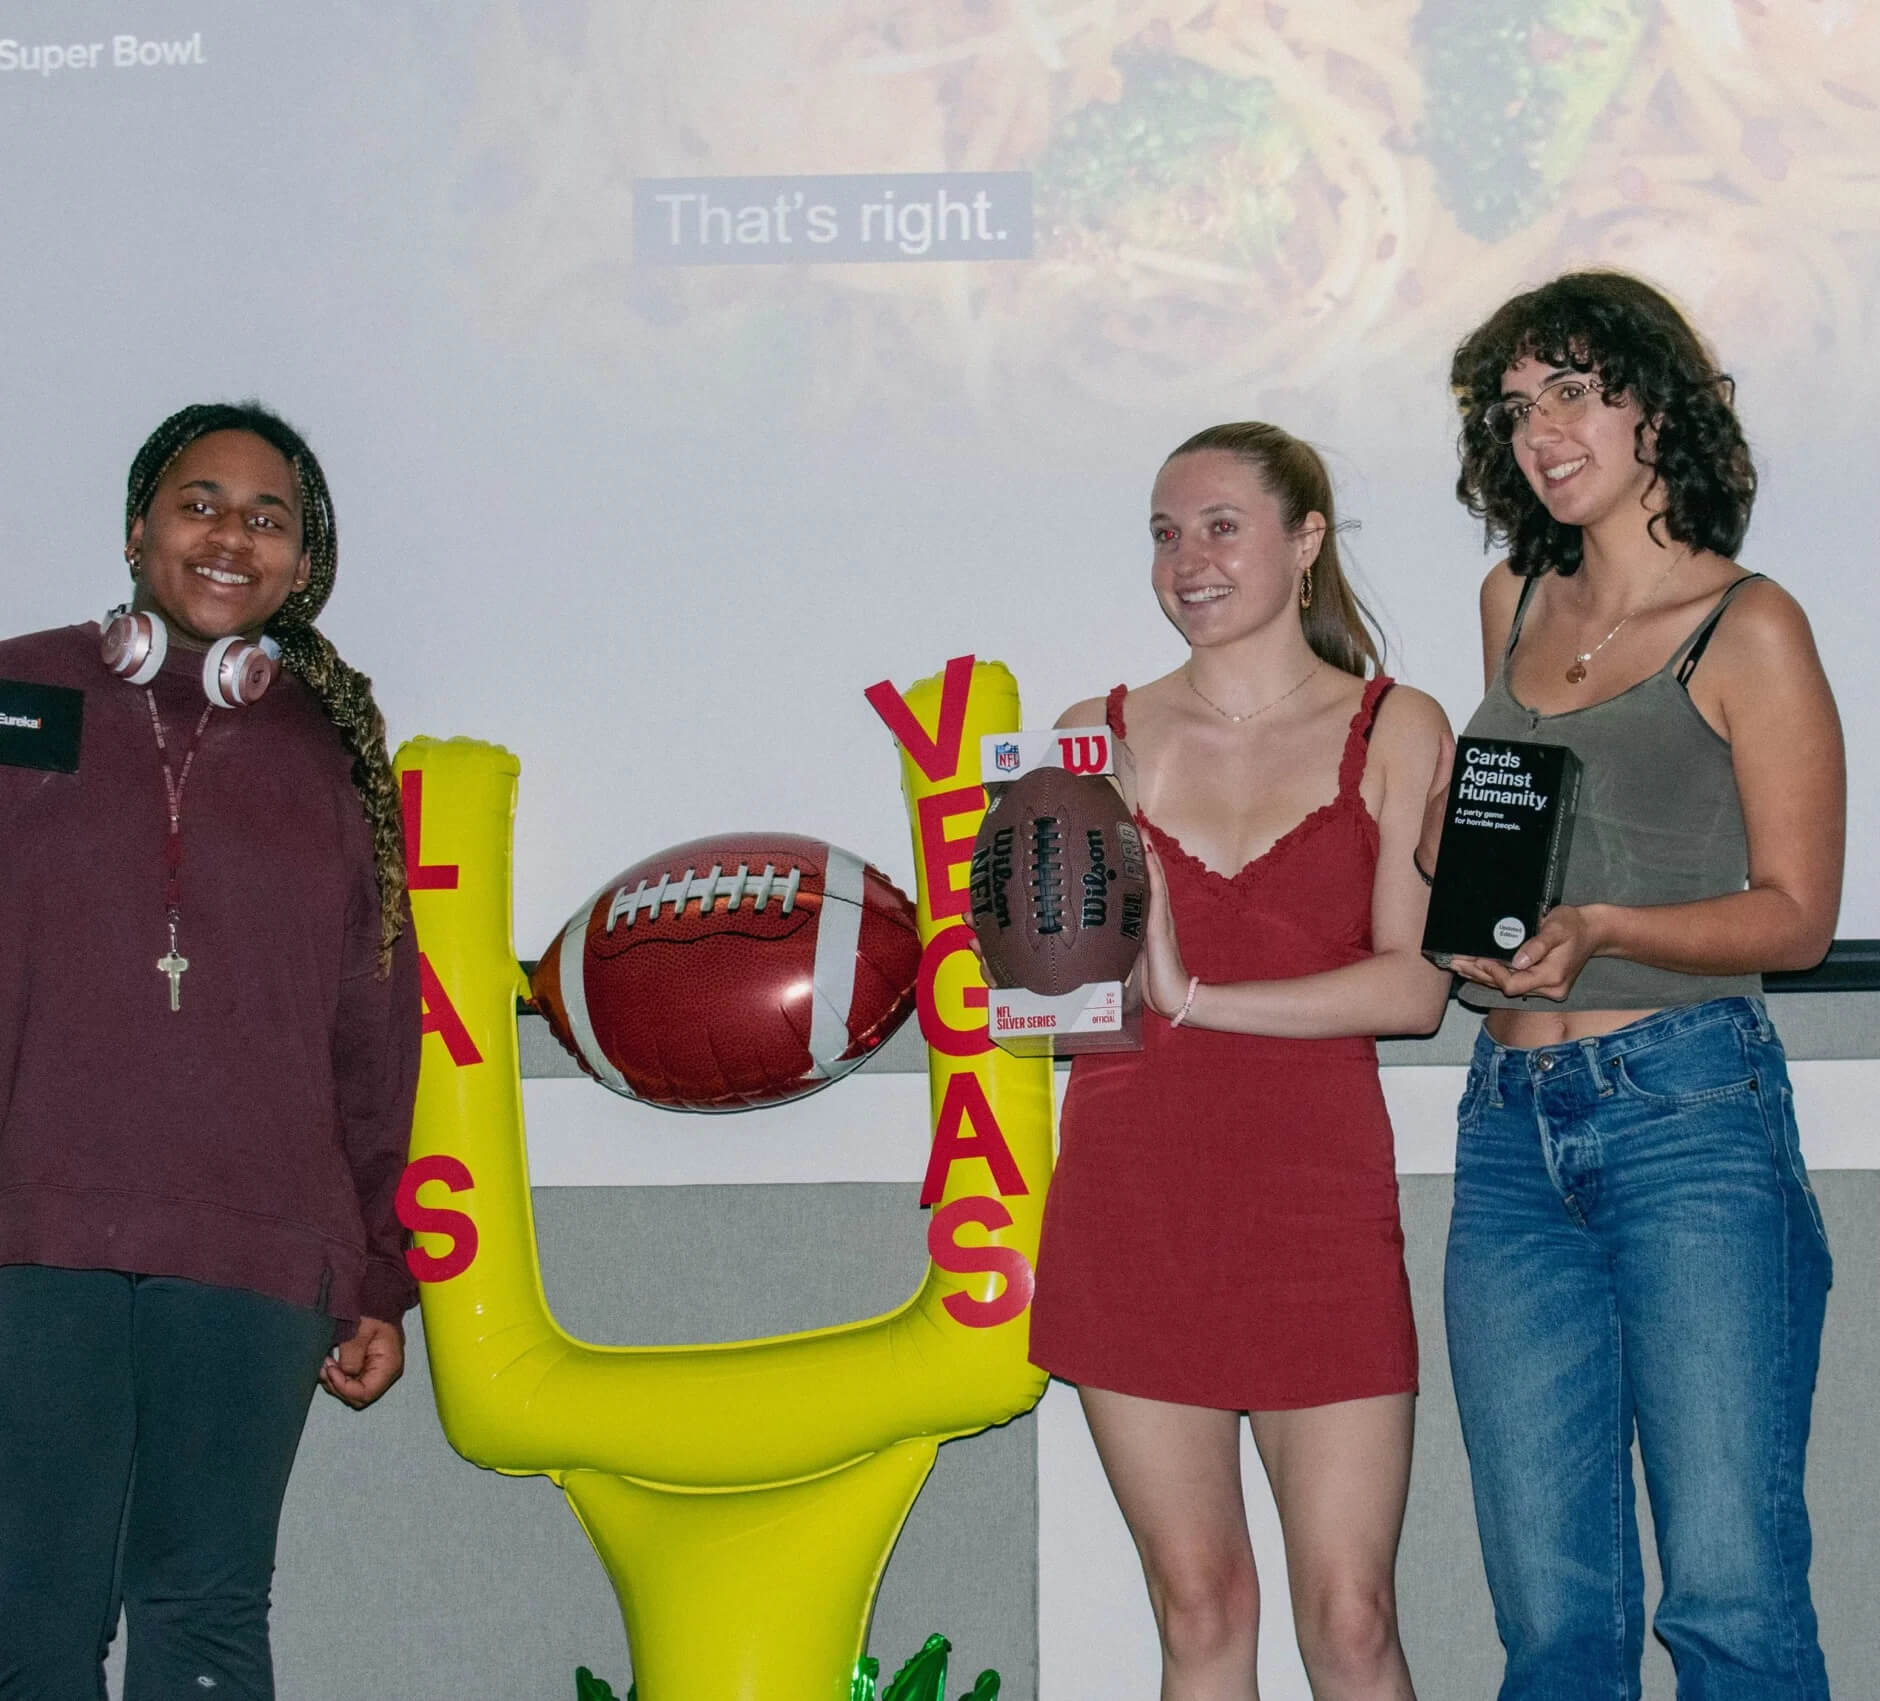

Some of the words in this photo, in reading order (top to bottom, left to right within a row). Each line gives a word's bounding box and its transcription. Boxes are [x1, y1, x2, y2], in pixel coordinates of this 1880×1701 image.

[0, 39, 104, 77] Super
[112, 32, 207, 67] Bowl
[655, 192, 839, 245] That’s
[861, 189, 1007, 254] right.
[999, 754, 1020, 768] NFL
[1465, 747, 1521, 769] Cards
[1461, 765, 1533, 788] Against
[1458, 782, 1548, 811] Humanity.
[1455, 816, 1466, 825] for
[1466, 818, 1494, 827] horrible
[1456, 807, 1463, 815] A
[1463, 808, 1483, 818] party
[1116, 821, 1146, 884] PRO
[993, 826, 1014, 928] Wilson
[1081, 829, 1108, 929] Wilson
[1120, 890, 1144, 941] ALL
[864, 654, 1035, 1329] VEGAS
[996, 1006, 1012, 1018] NFL
[997, 1016, 1025, 1030] SILVER
[1028, 1015, 1056, 1029] SERIES
[1092, 1015, 1115, 1025] OFFICIAL
